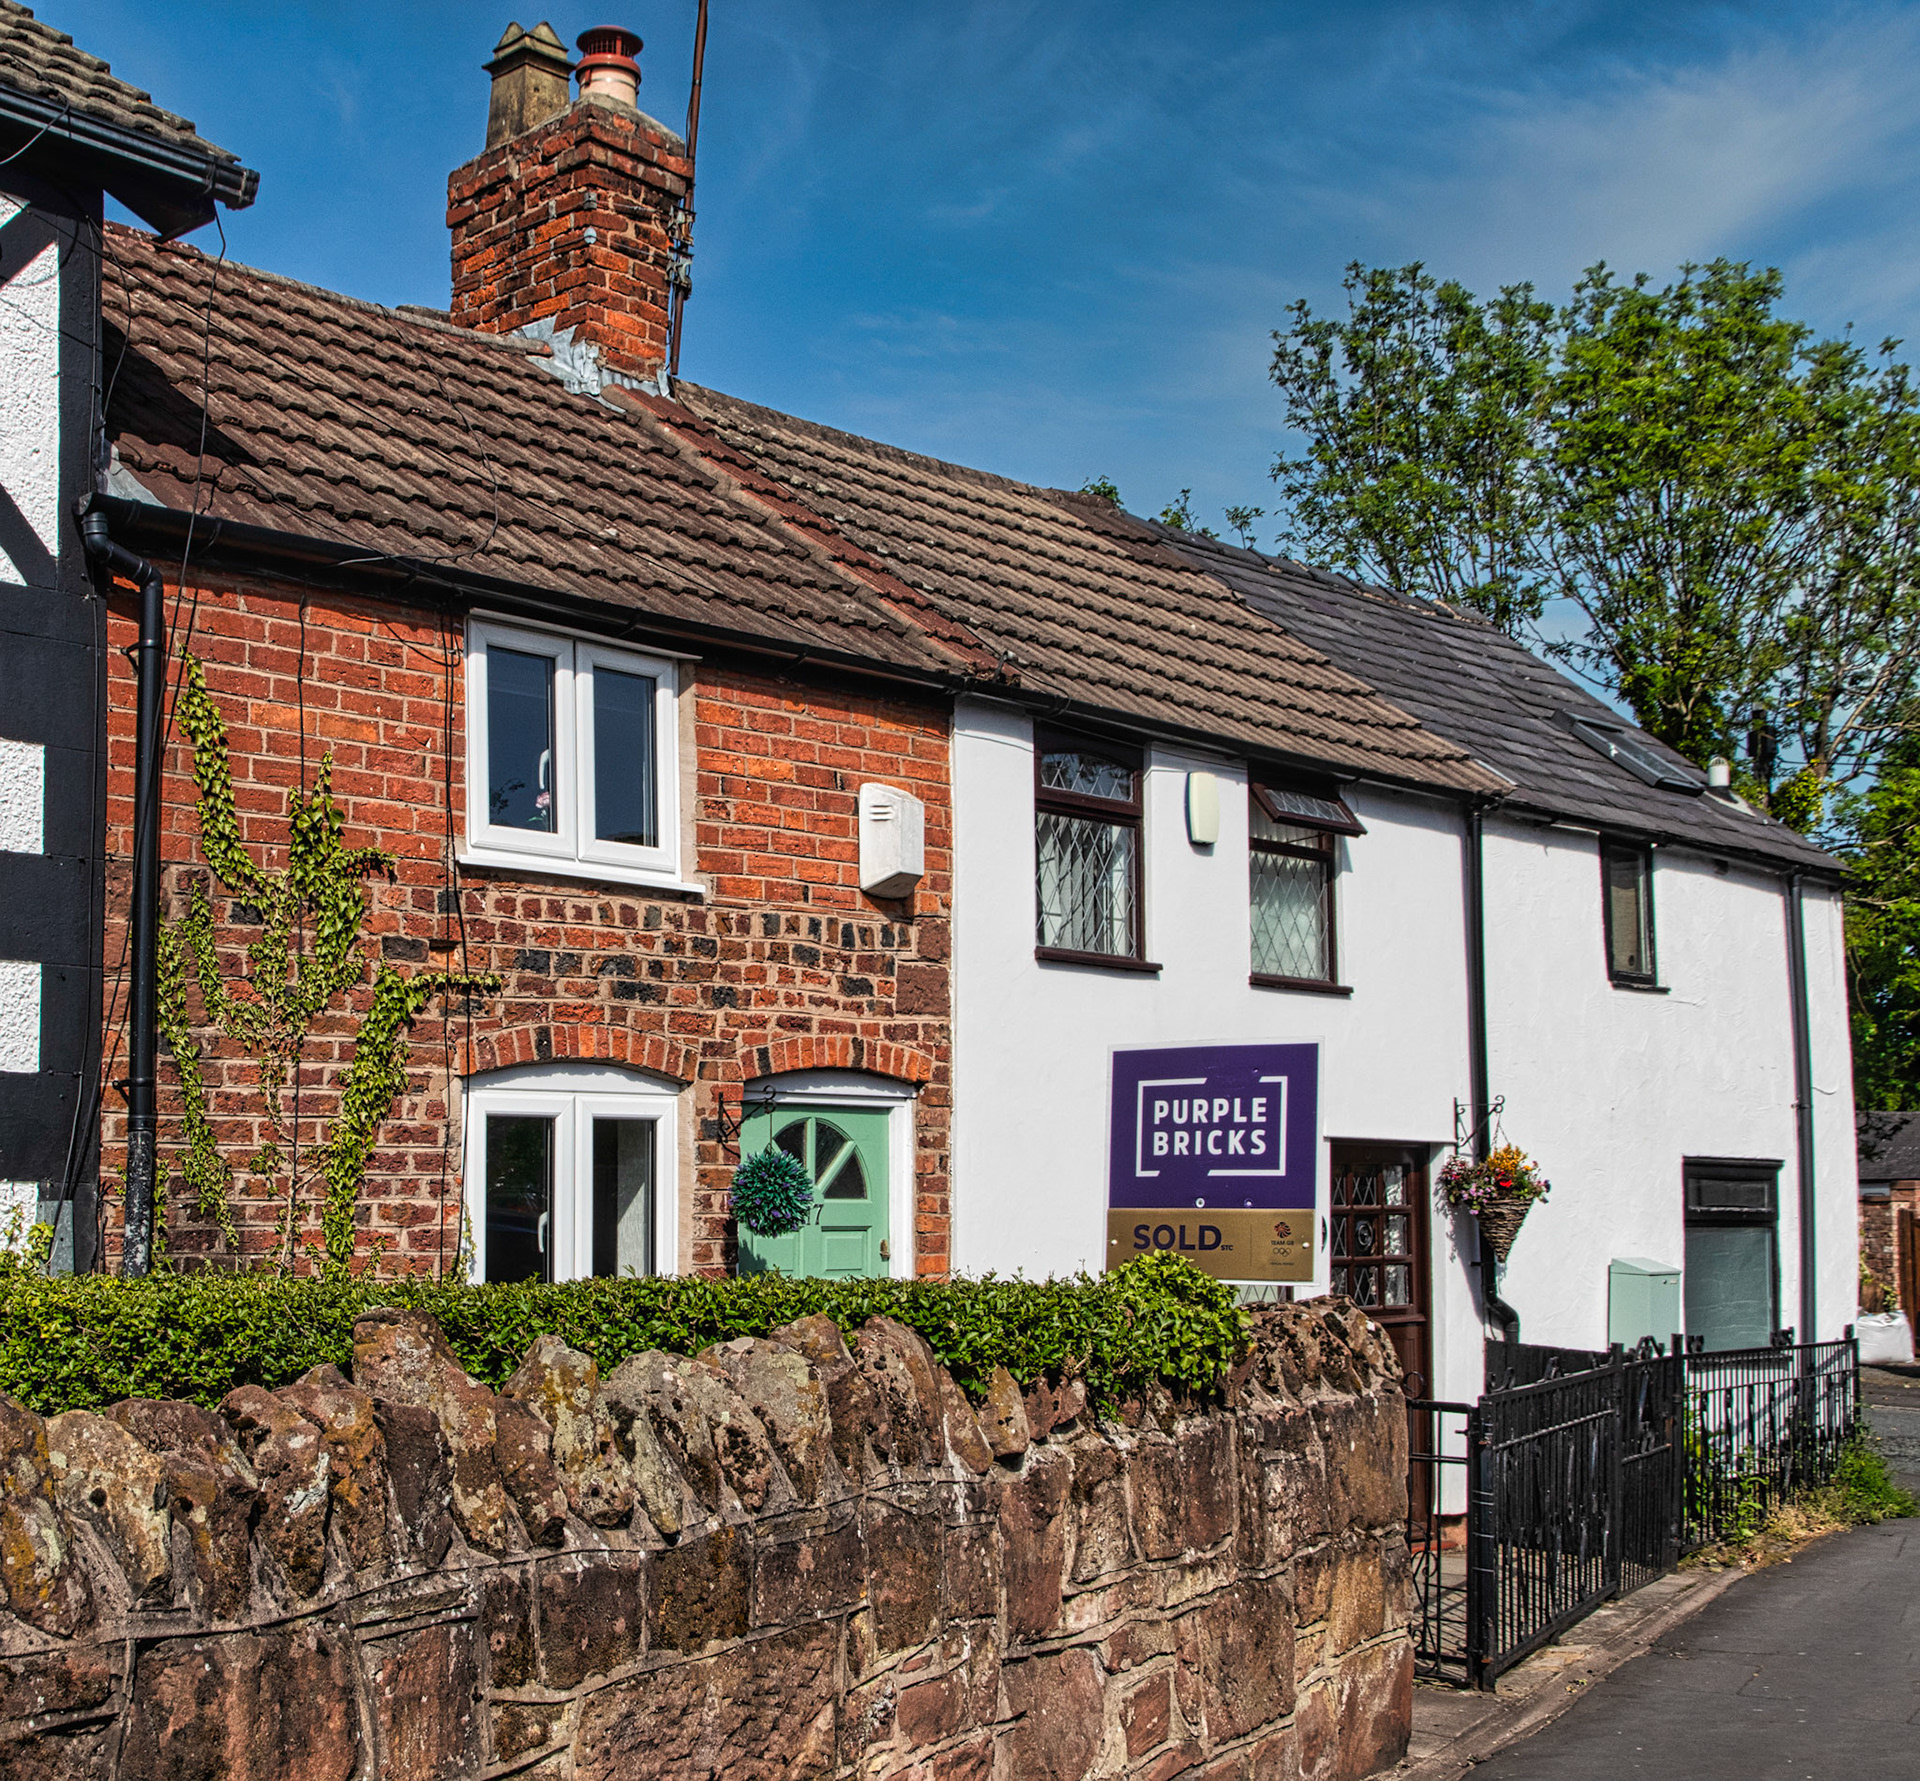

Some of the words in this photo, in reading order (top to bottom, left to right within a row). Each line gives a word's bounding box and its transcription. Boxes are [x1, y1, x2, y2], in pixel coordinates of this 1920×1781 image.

[1153, 1097, 1268, 1125] PURPLE
[1152, 1129, 1267, 1156] BRICKS
[1133, 1224, 1222, 1252] SOLD
